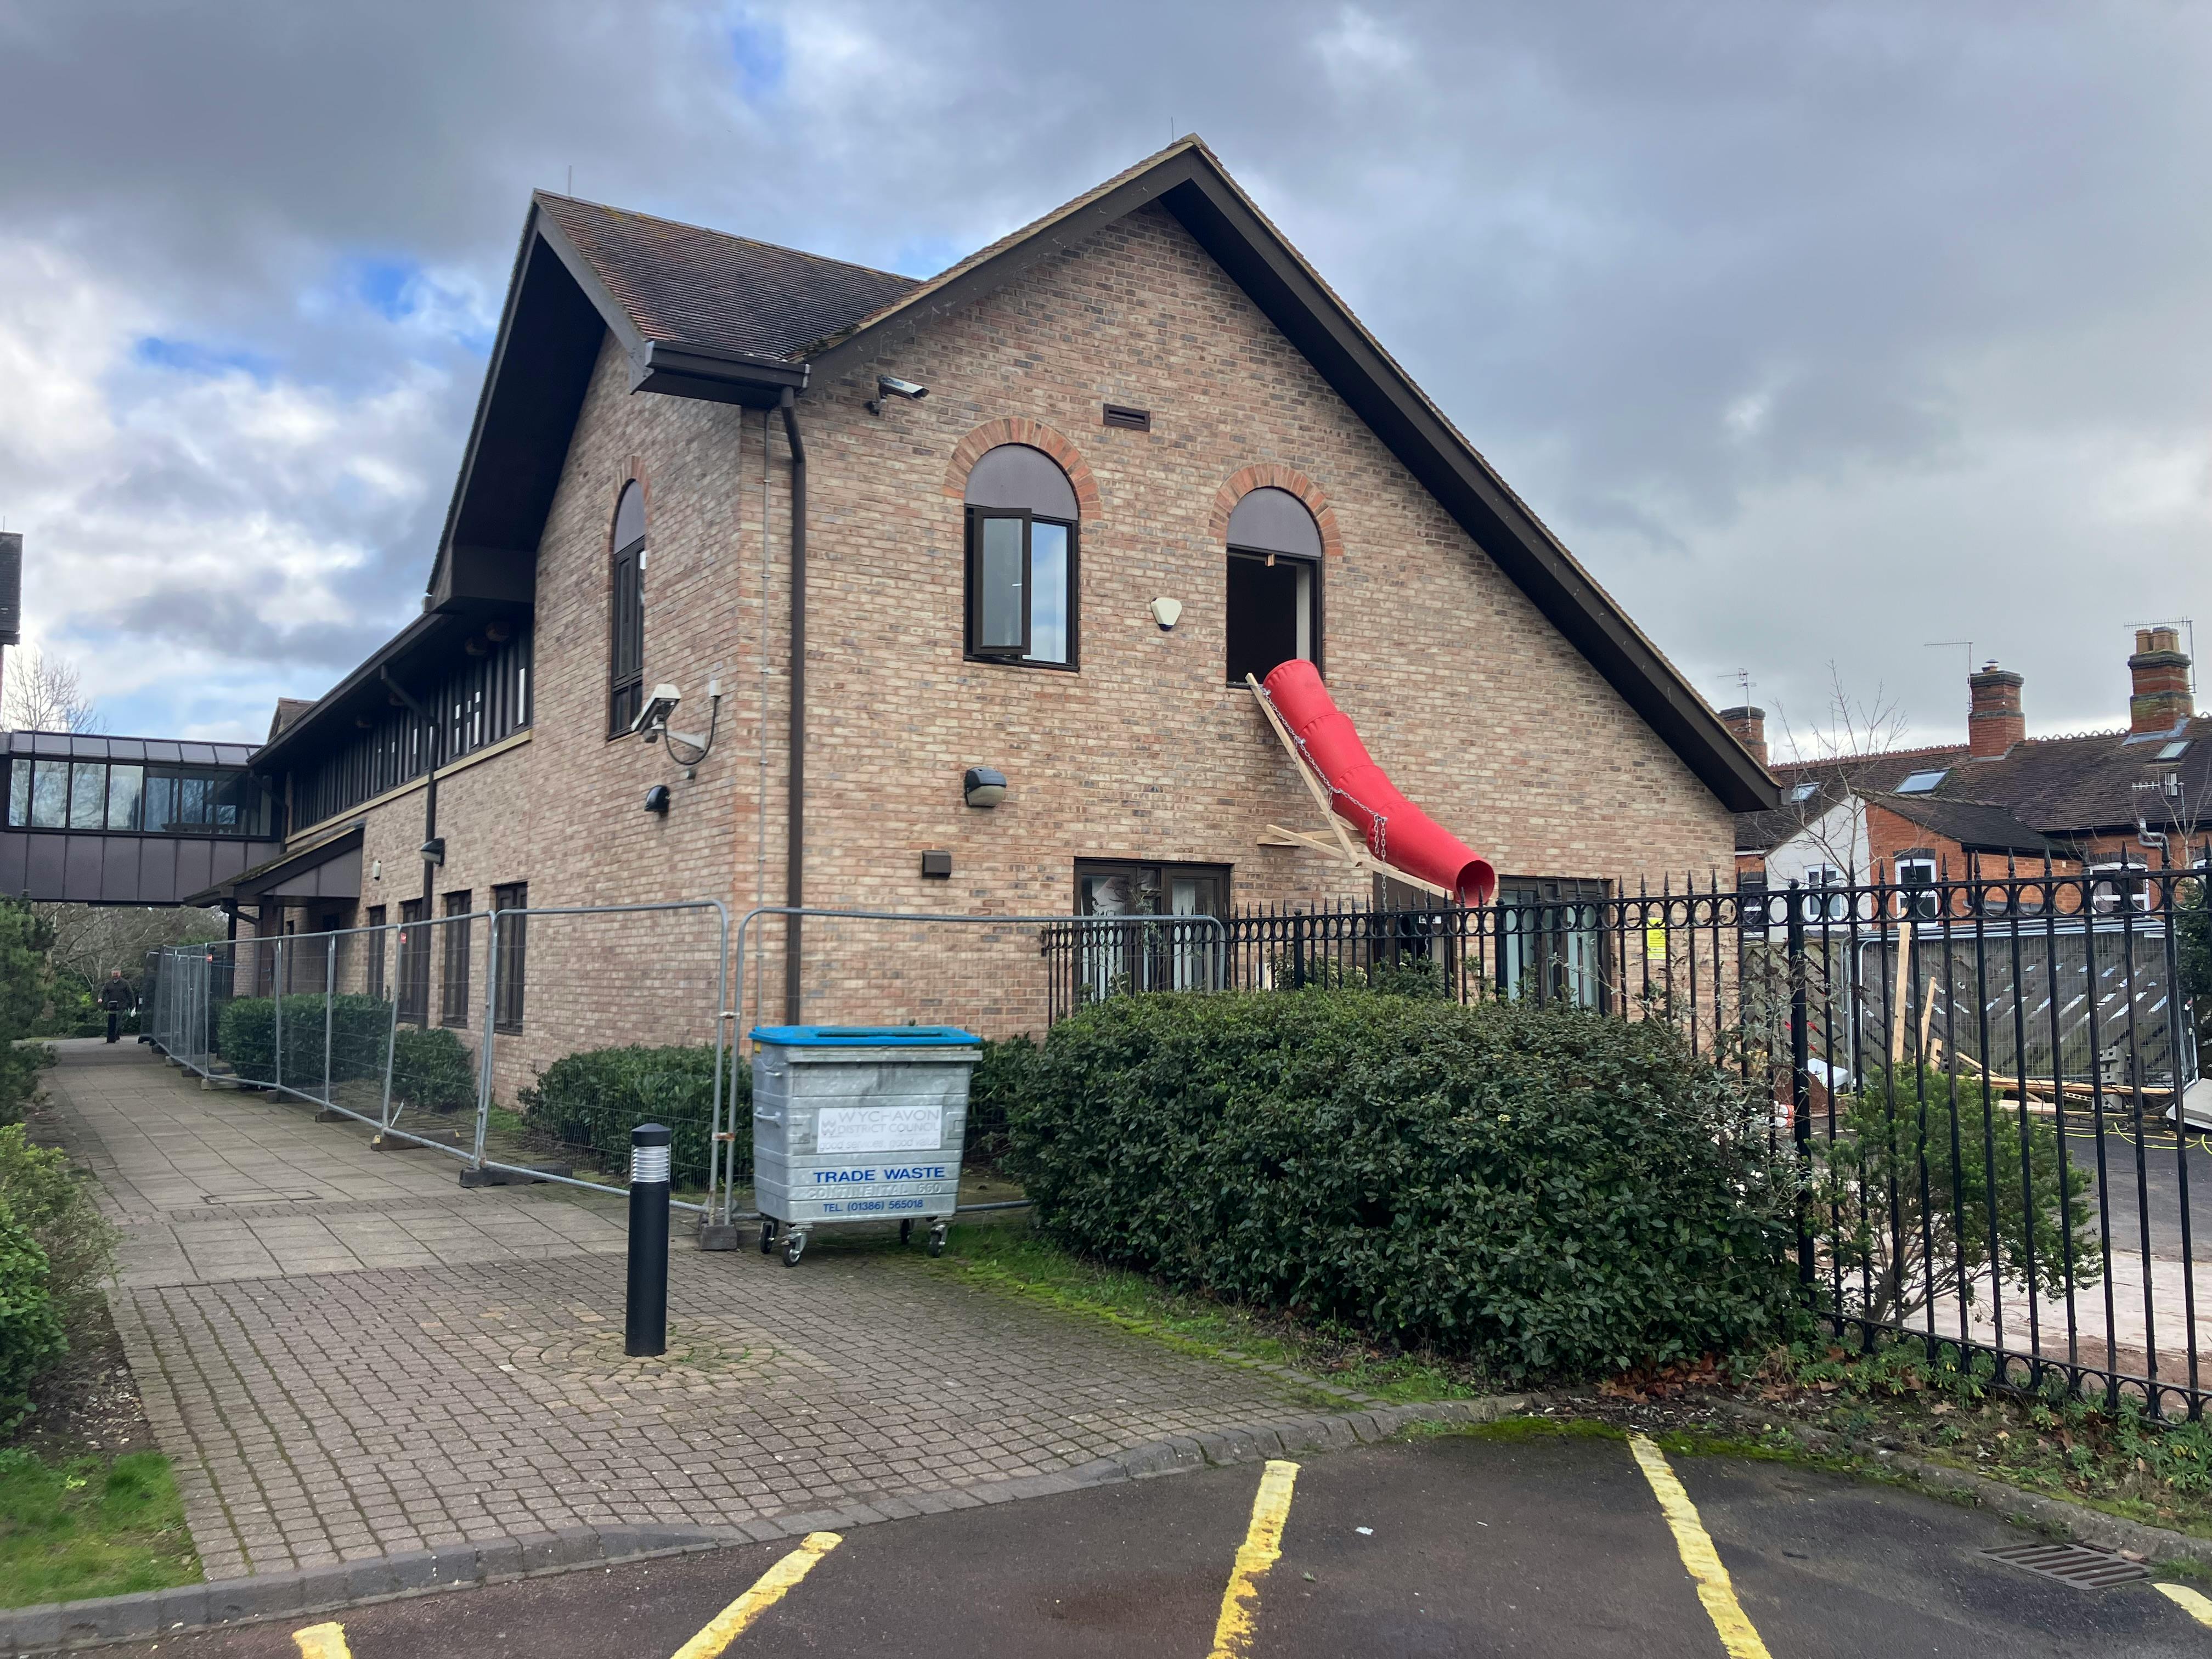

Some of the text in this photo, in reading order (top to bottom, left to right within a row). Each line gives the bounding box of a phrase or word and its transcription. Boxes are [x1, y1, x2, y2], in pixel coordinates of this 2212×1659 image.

[838, 1122, 939, 1133] DISTRICT COUNCIL
[813, 1167, 945, 1183] TRADE WASTE
[805, 1183, 941, 1199] CONTINENTAL 660
[848, 1201, 884, 1211] (01386)
[888, 1199, 923, 1209] 565018
